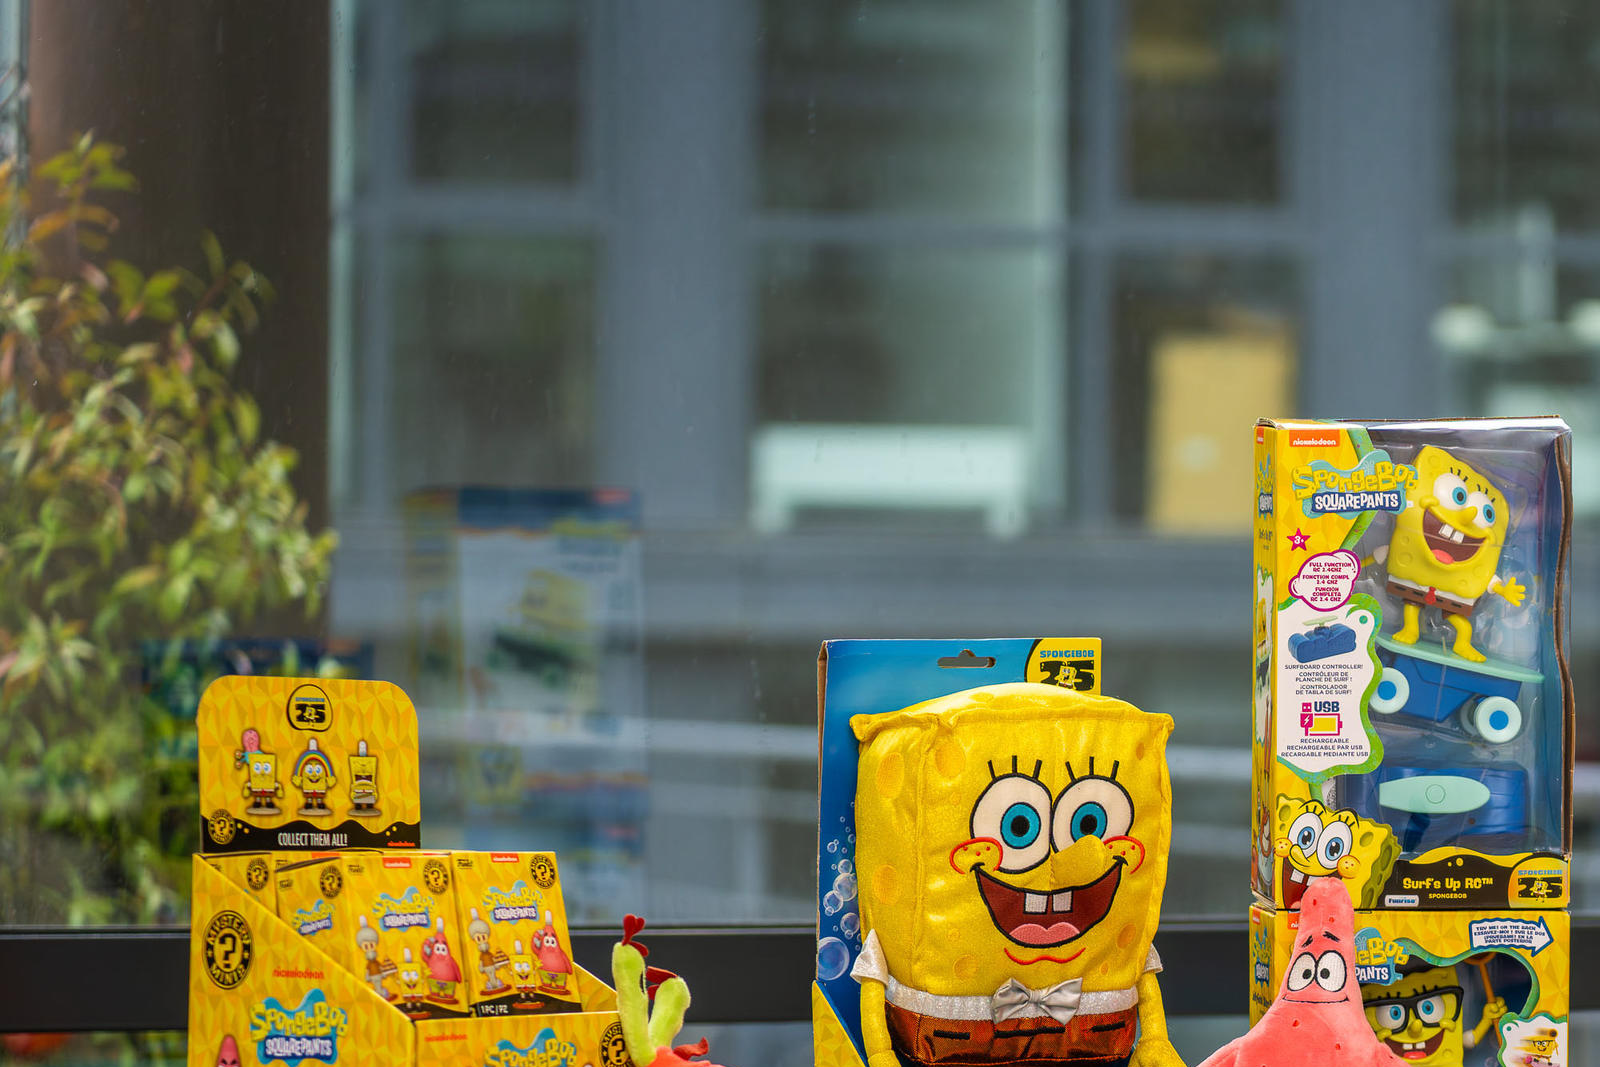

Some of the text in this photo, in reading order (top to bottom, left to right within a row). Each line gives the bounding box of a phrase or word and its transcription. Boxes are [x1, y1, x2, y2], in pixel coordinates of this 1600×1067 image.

[1293, 437, 1336, 446] nickelodeon
[1292, 461, 1418, 500] SpongeBob
[1314, 492, 1399, 511] SQUAREPANTS
[1040, 650, 1095, 659] SPONGEBOB
[1040, 660, 1095, 691] 25
[1314, 701, 1340, 712] USB
[278, 833, 348, 846] COLLECT THEM ALL!
[1403, 877, 1461, 891] Surf's Up
[250, 1001, 348, 1042] SpongeBob
[265, 1037, 332, 1057] SQUAREPANTS
